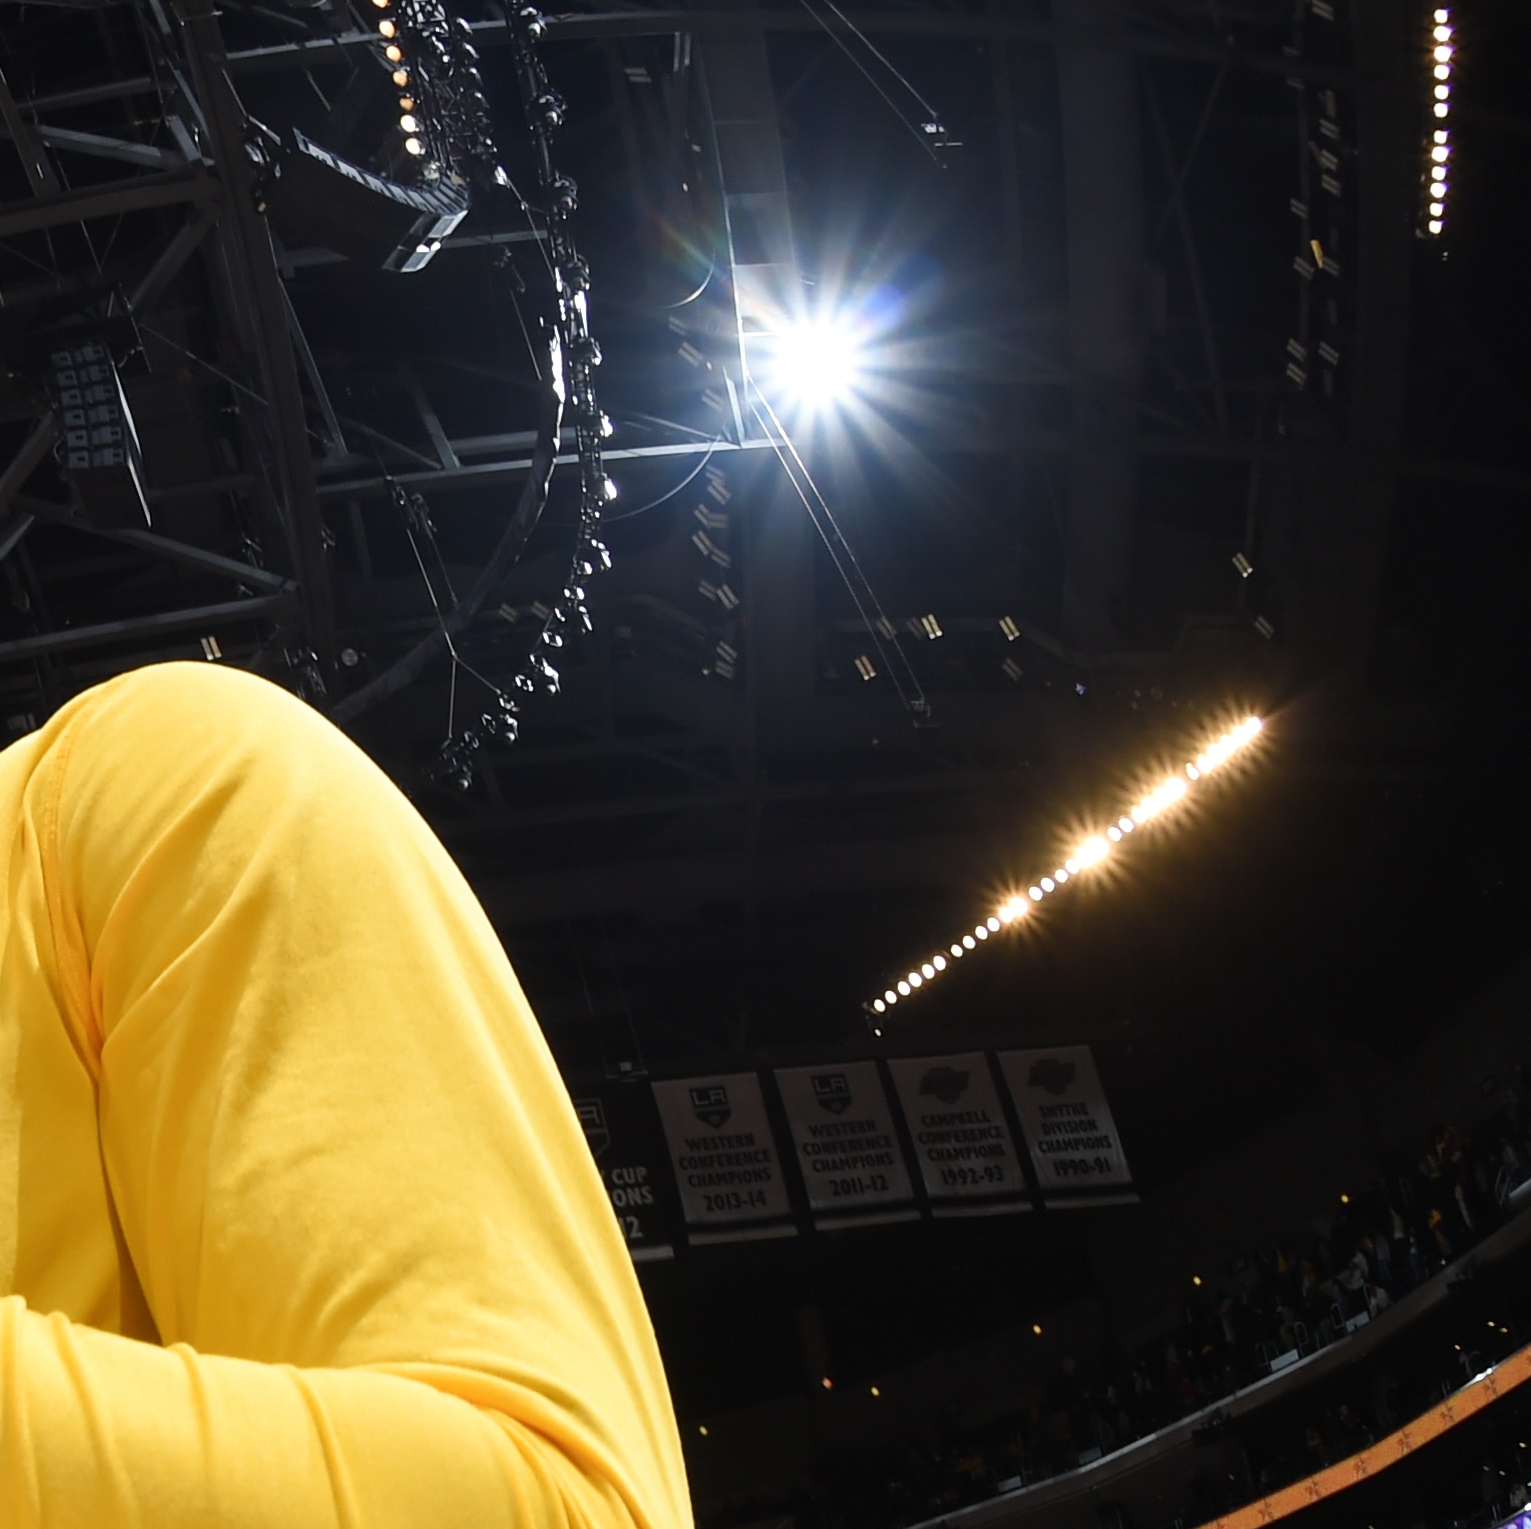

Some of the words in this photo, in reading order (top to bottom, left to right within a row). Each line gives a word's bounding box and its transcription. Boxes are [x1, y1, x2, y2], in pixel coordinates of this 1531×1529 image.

[921, 1109, 991, 1127] CAMPBELL
[1039, 1102, 1089, 1118] SMYTHE
[808, 1119, 877, 1138] WESTERN
[918, 1126, 1005, 1144] CONFERENCE
[1041, 1119, 1097, 1135] DIVISION
[685, 1132, 755, 1151] WESTERN
[802, 1135, 894, 1156] CONFERENCE
[1038, 1136, 1112, 1154] CHAMPIONS
[679, 1149, 772, 1170] CONFERENCE
[927, 1143, 1005, 1162] CHAMPIONS
[812, 1152, 893, 1173] CHAMPIONS
[1053, 1157, 1111, 1176] 1990-91
[611, 1166, 648, 1185] CUP
[688, 1167, 771, 1187] CHAMPIONS
[940, 1164, 1004, 1184] 1992-93
[829, 1175, 890, 1197] 2011-12
[612, 1185, 653, 1208] ONS
[703, 1190, 767, 1212] 2013-14
